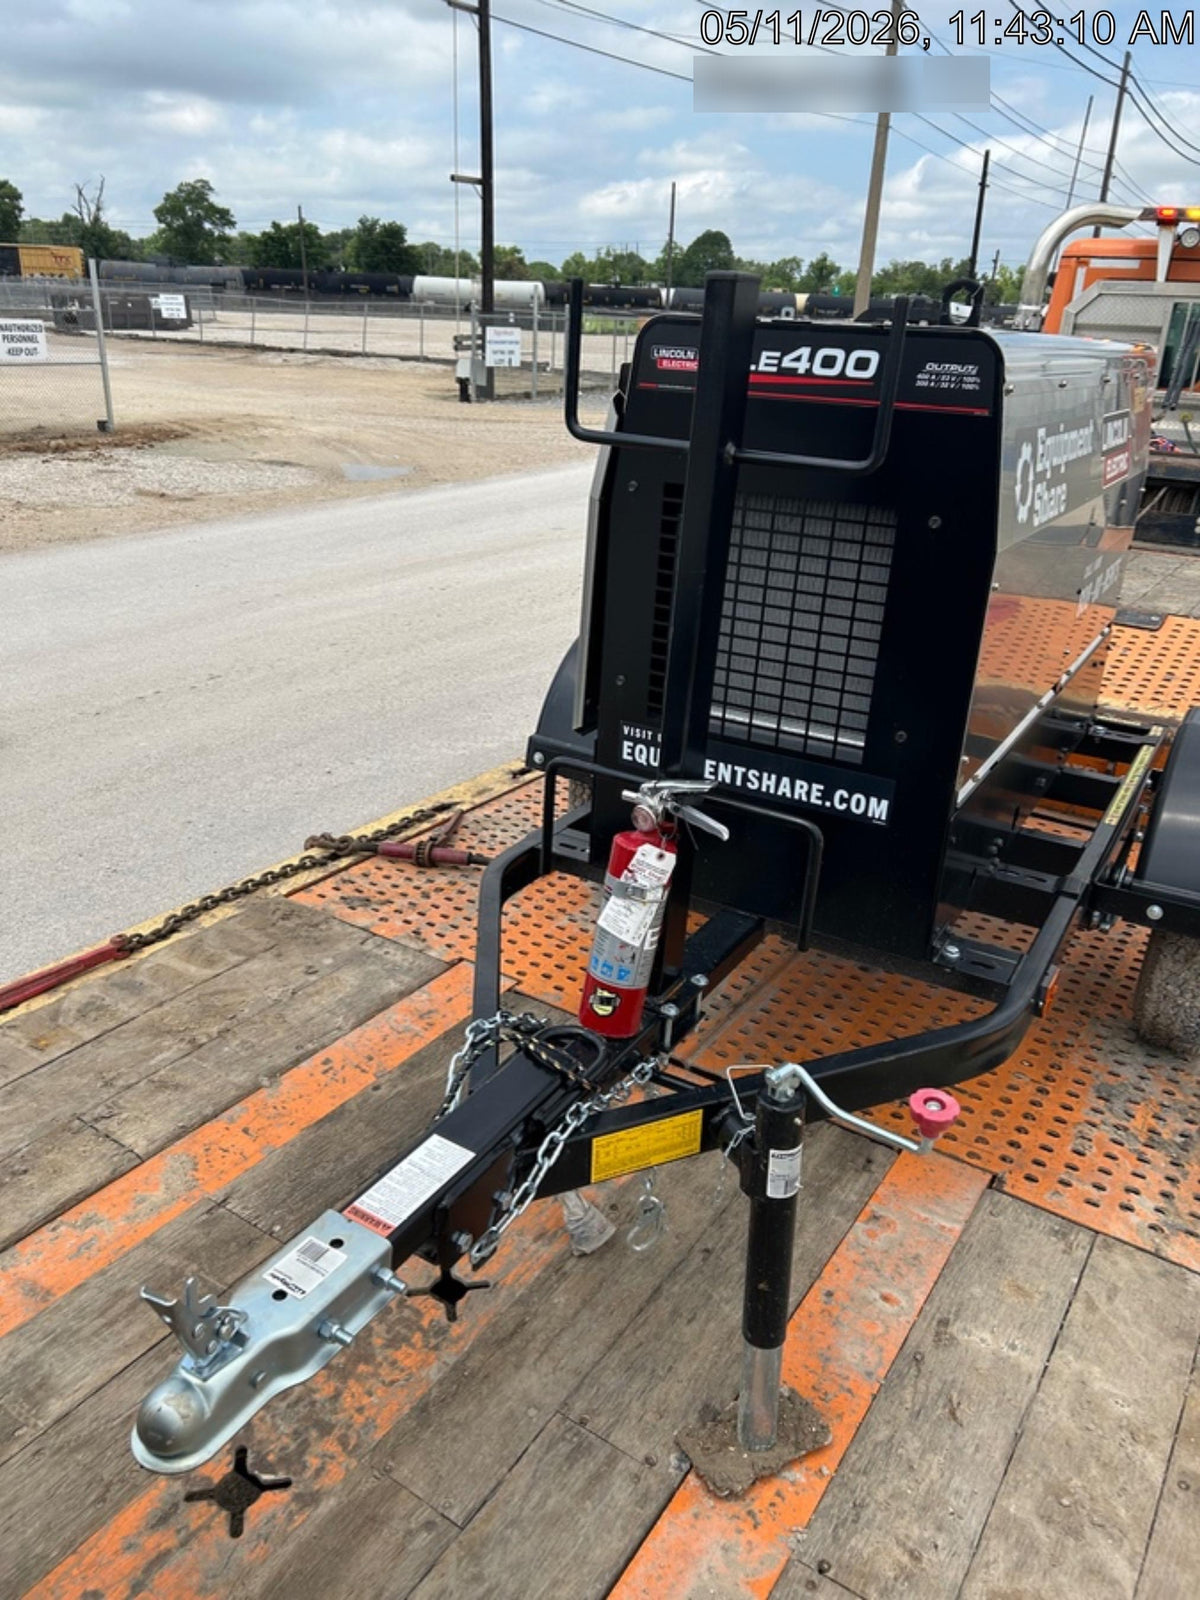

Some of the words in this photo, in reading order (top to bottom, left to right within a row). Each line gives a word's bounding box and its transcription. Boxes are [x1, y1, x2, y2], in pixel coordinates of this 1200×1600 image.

[0, 323, 43, 333] NAUTHORIZED
[2, 334, 39, 344] PERSONNEL
[653, 347, 695, 360] LINCOLN
[661, 359, 699, 370] ELECTRIC
[1036, 419, 1094, 480] Equipment
[1033, 481, 1067, 527] Share
[622, 724, 653, 741] VISIT
